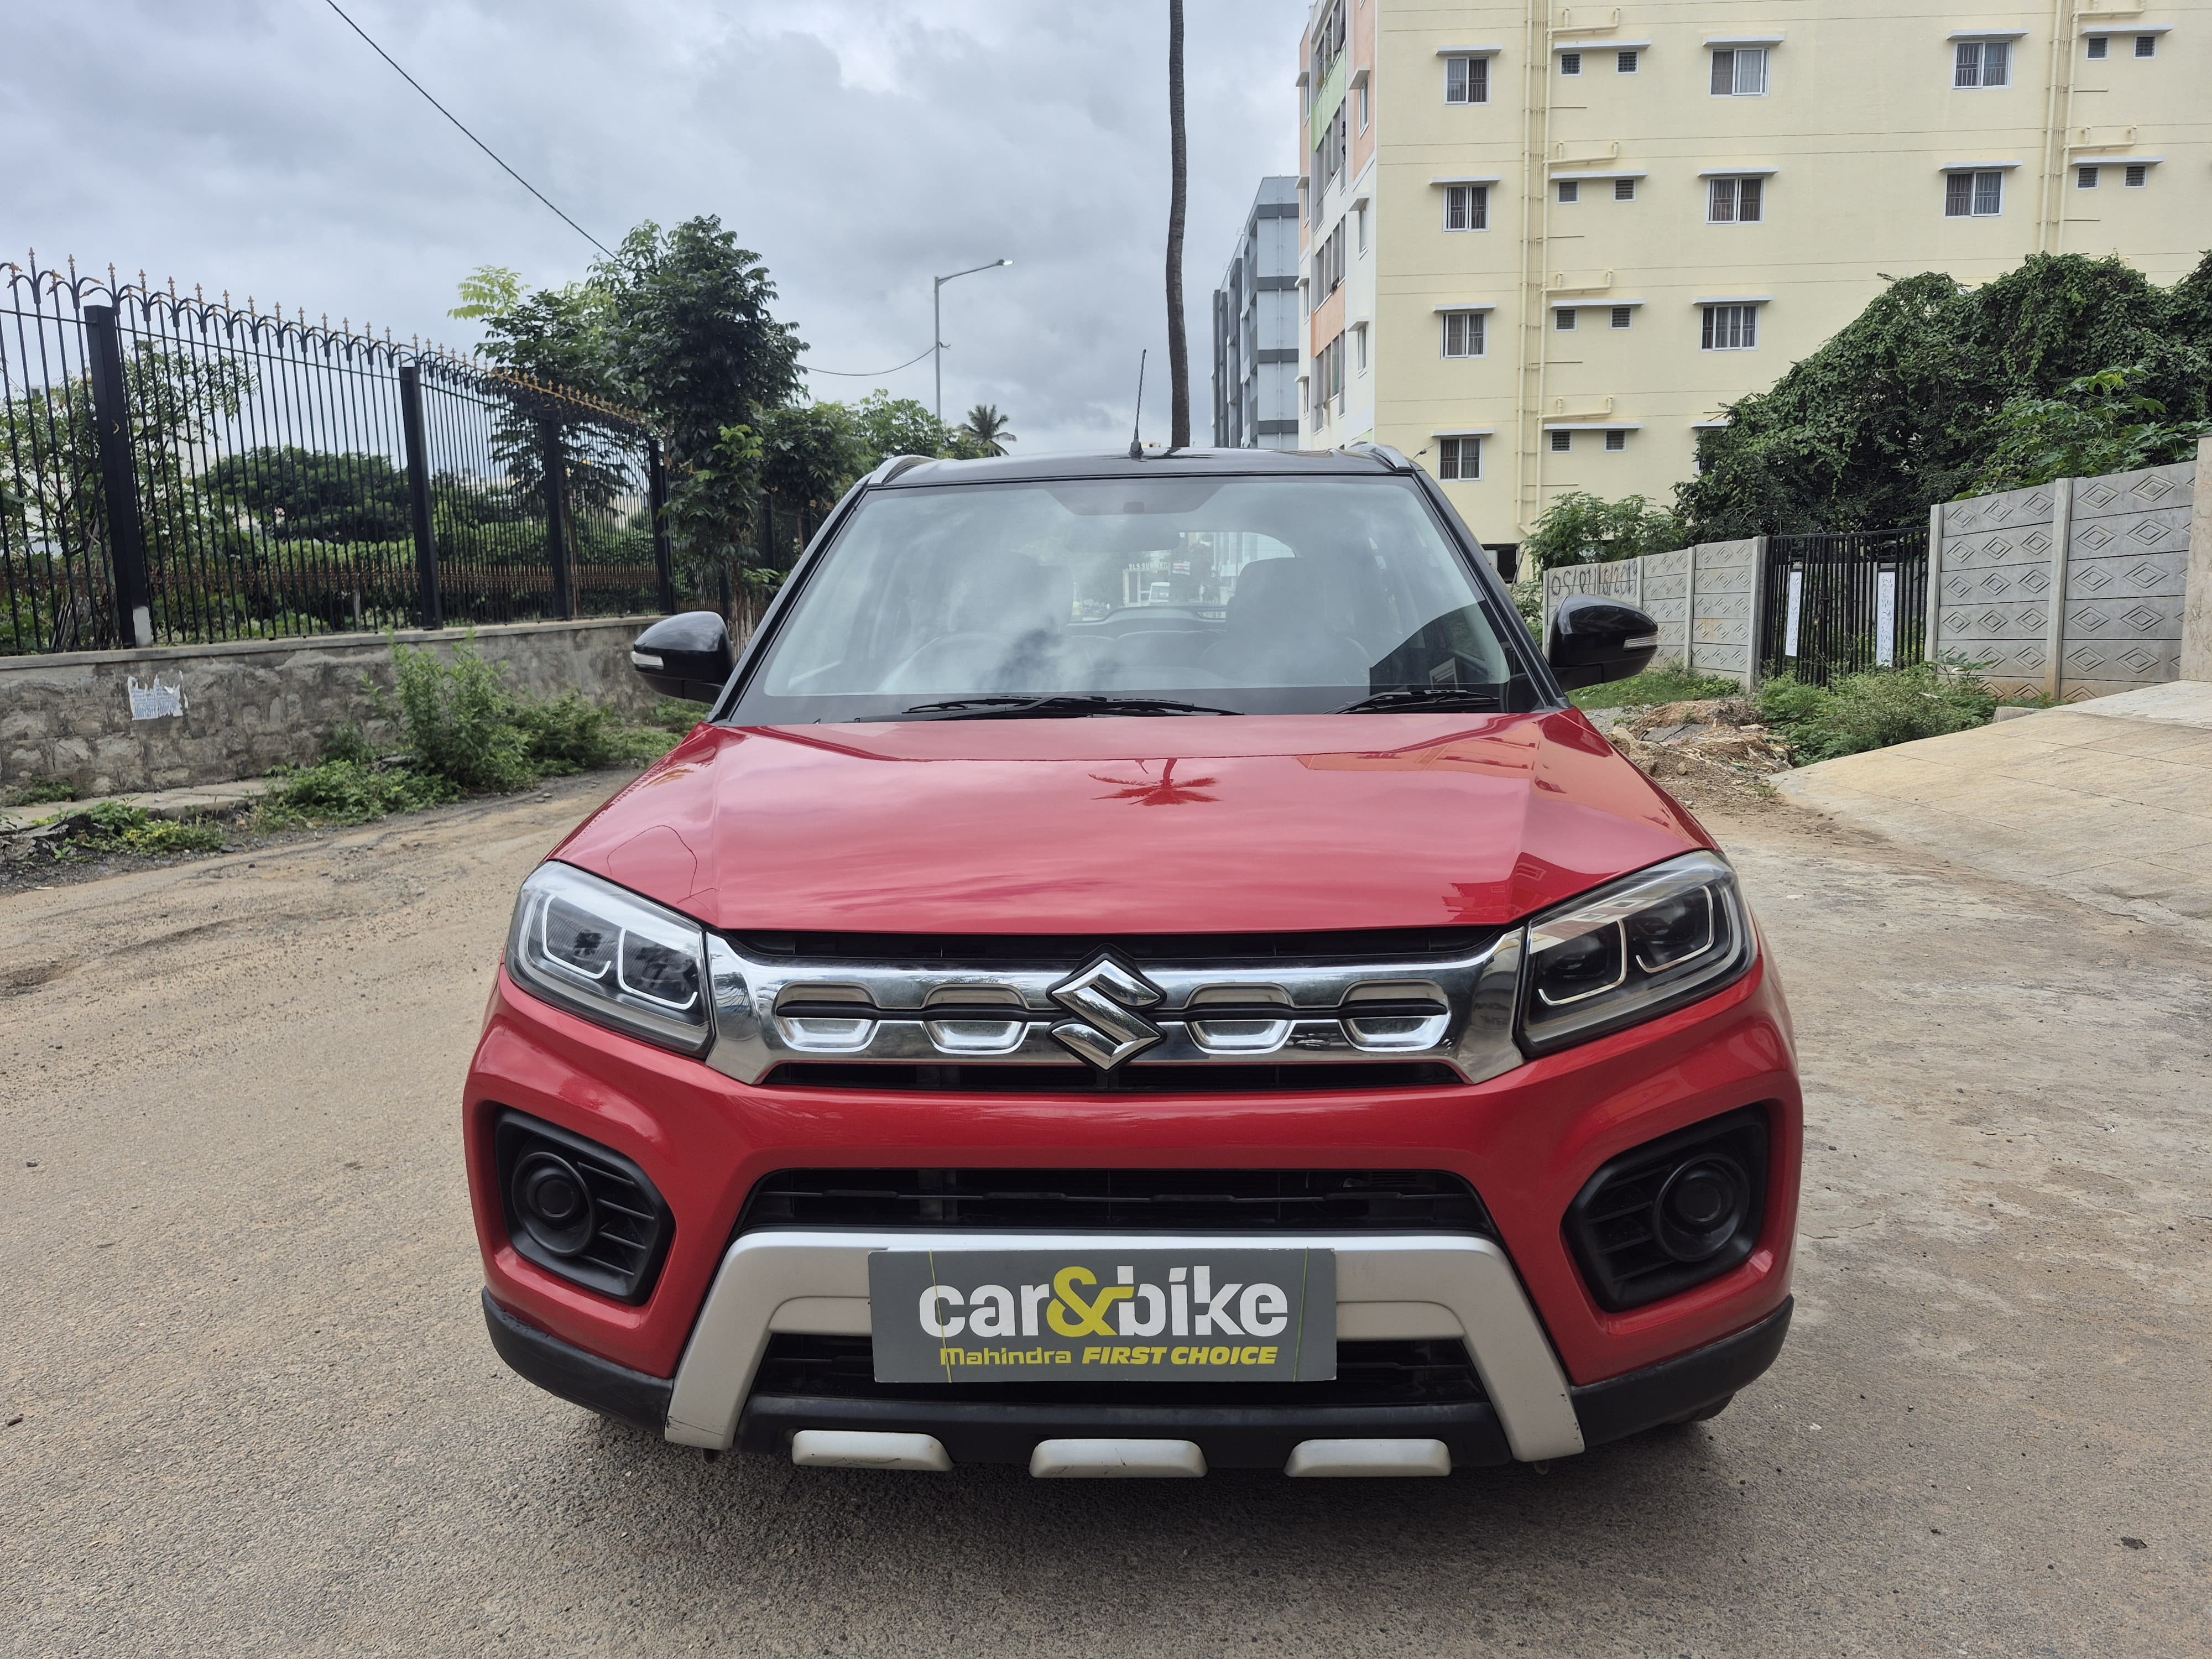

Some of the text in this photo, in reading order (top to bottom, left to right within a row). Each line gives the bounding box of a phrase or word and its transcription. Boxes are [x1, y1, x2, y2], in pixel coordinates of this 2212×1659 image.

[919, 1265, 1288, 1338] car&bike
[940, 1346, 1279, 1365] Mahindra FIRST CHOICE
